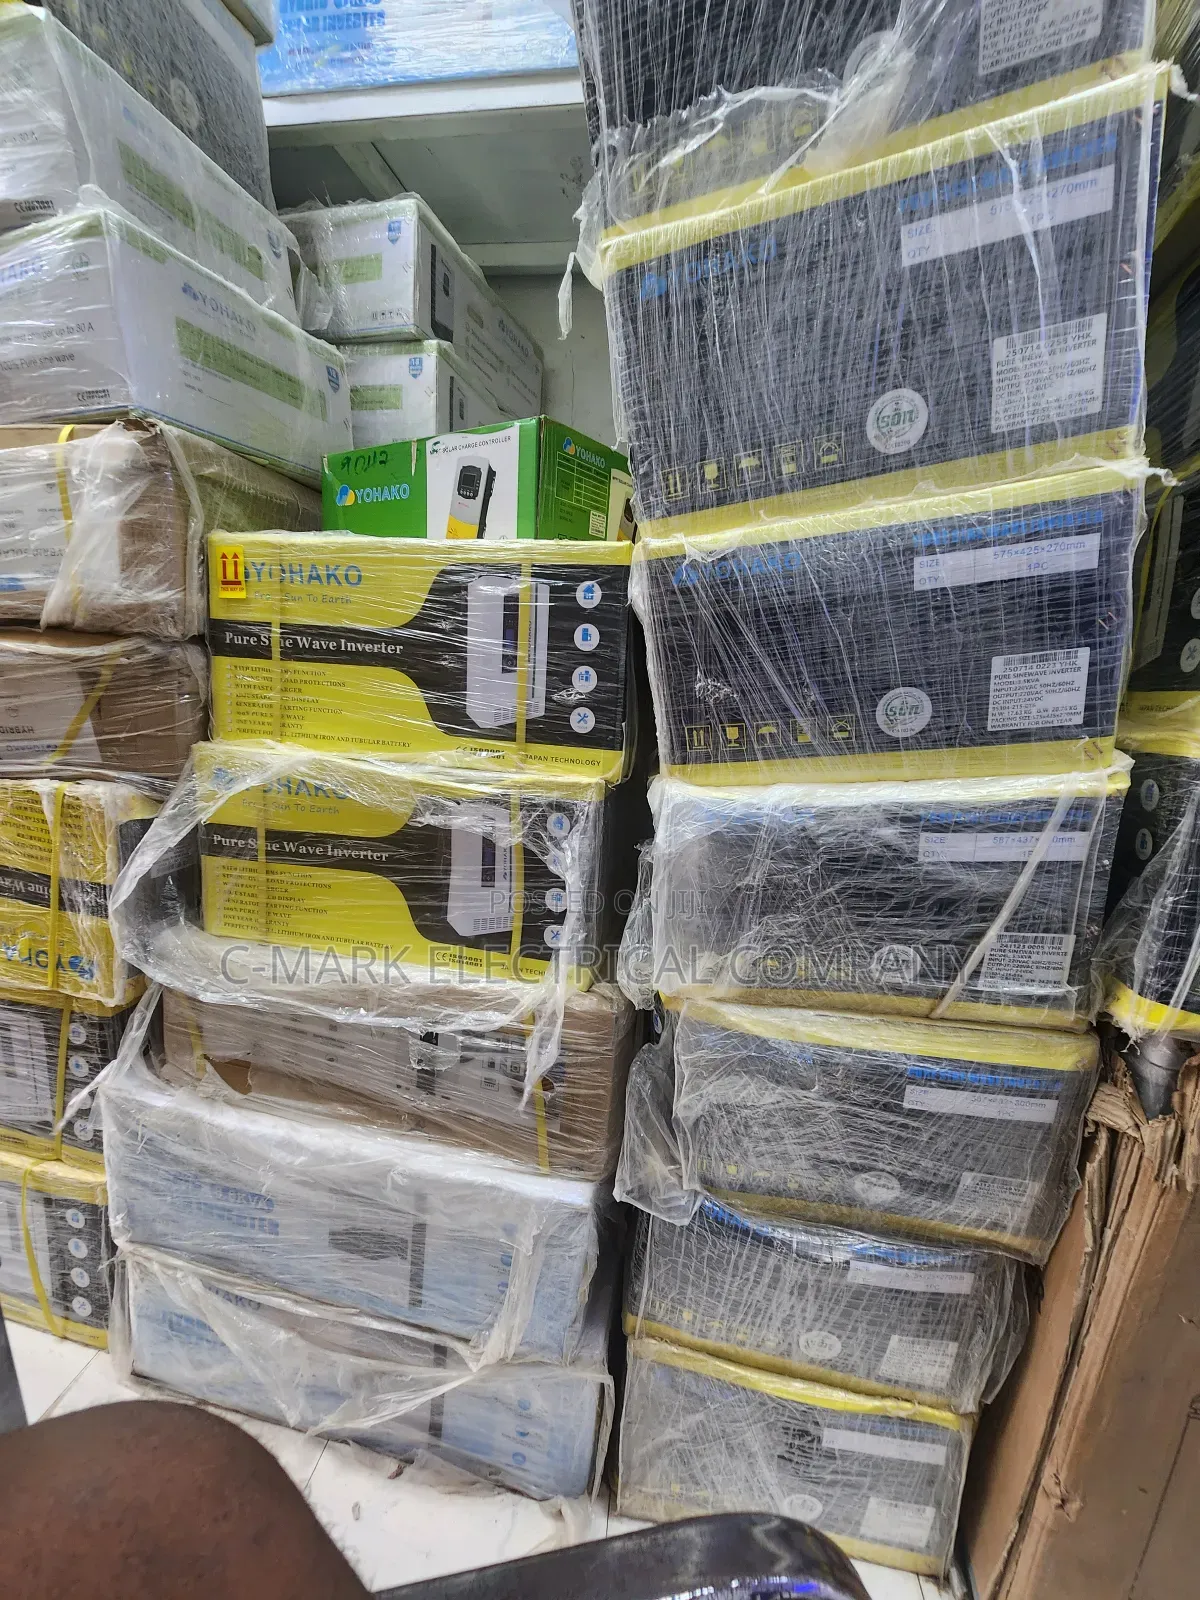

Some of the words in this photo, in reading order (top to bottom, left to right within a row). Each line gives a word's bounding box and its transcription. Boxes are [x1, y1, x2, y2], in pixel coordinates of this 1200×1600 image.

[87, 322, 95, 332] A
[458, 441, 478, 451] CHARGE
[478, 435, 512, 448] CONTROLLER
[575, 445, 606, 469] YOHAKO
[355, 483, 411, 504] YOHAKO
[251, 561, 363, 587] YOHAKO
[1027, 561, 1049, 573] 1PC
[284, 592, 303, 602] Sun
[307, 593, 318, 603] To
[321, 594, 352, 605] Earth
[225, 631, 259, 646] Pure
[260, 634, 294, 649] Sne
[297, 636, 338, 651] Wave
[340, 638, 404, 655] Inverter
[294, 669, 327, 677] FUNCTION
[994, 673, 1011, 682] PURE
[1012, 670, 1048, 679] SINEWAVE
[1049, 666, 1082, 675] INVERTER
[299, 678, 346, 688] PROTECTIONS
[280, 705, 308, 713] TARTING
[309, 707, 343, 715] FUNCTION
[291, 732, 319, 740] LITHIUM
[319, 734, 336, 742] IRON
[337, 735, 350, 743] AND
[351, 737, 381, 746] TUBULAR
[382, 740, 412, 749] BATTERY
[523, 752, 548, 763] JAPAN
[550, 756, 601, 767] TECHNOLOGY
[272, 801, 291, 811] Sun
[294, 803, 306, 812] To
[309, 804, 340, 815] Earth
[213, 833, 246, 848] Pure
[283, 841, 324, 856] Wave
[327, 844, 389, 862] Inverter
[277, 929, 305, 937] LITHIUM
[305, 932, 321, 940] IRON
[336, 937, 364, 946] TUBULAR
[449, 953, 483, 963] ISO9001
